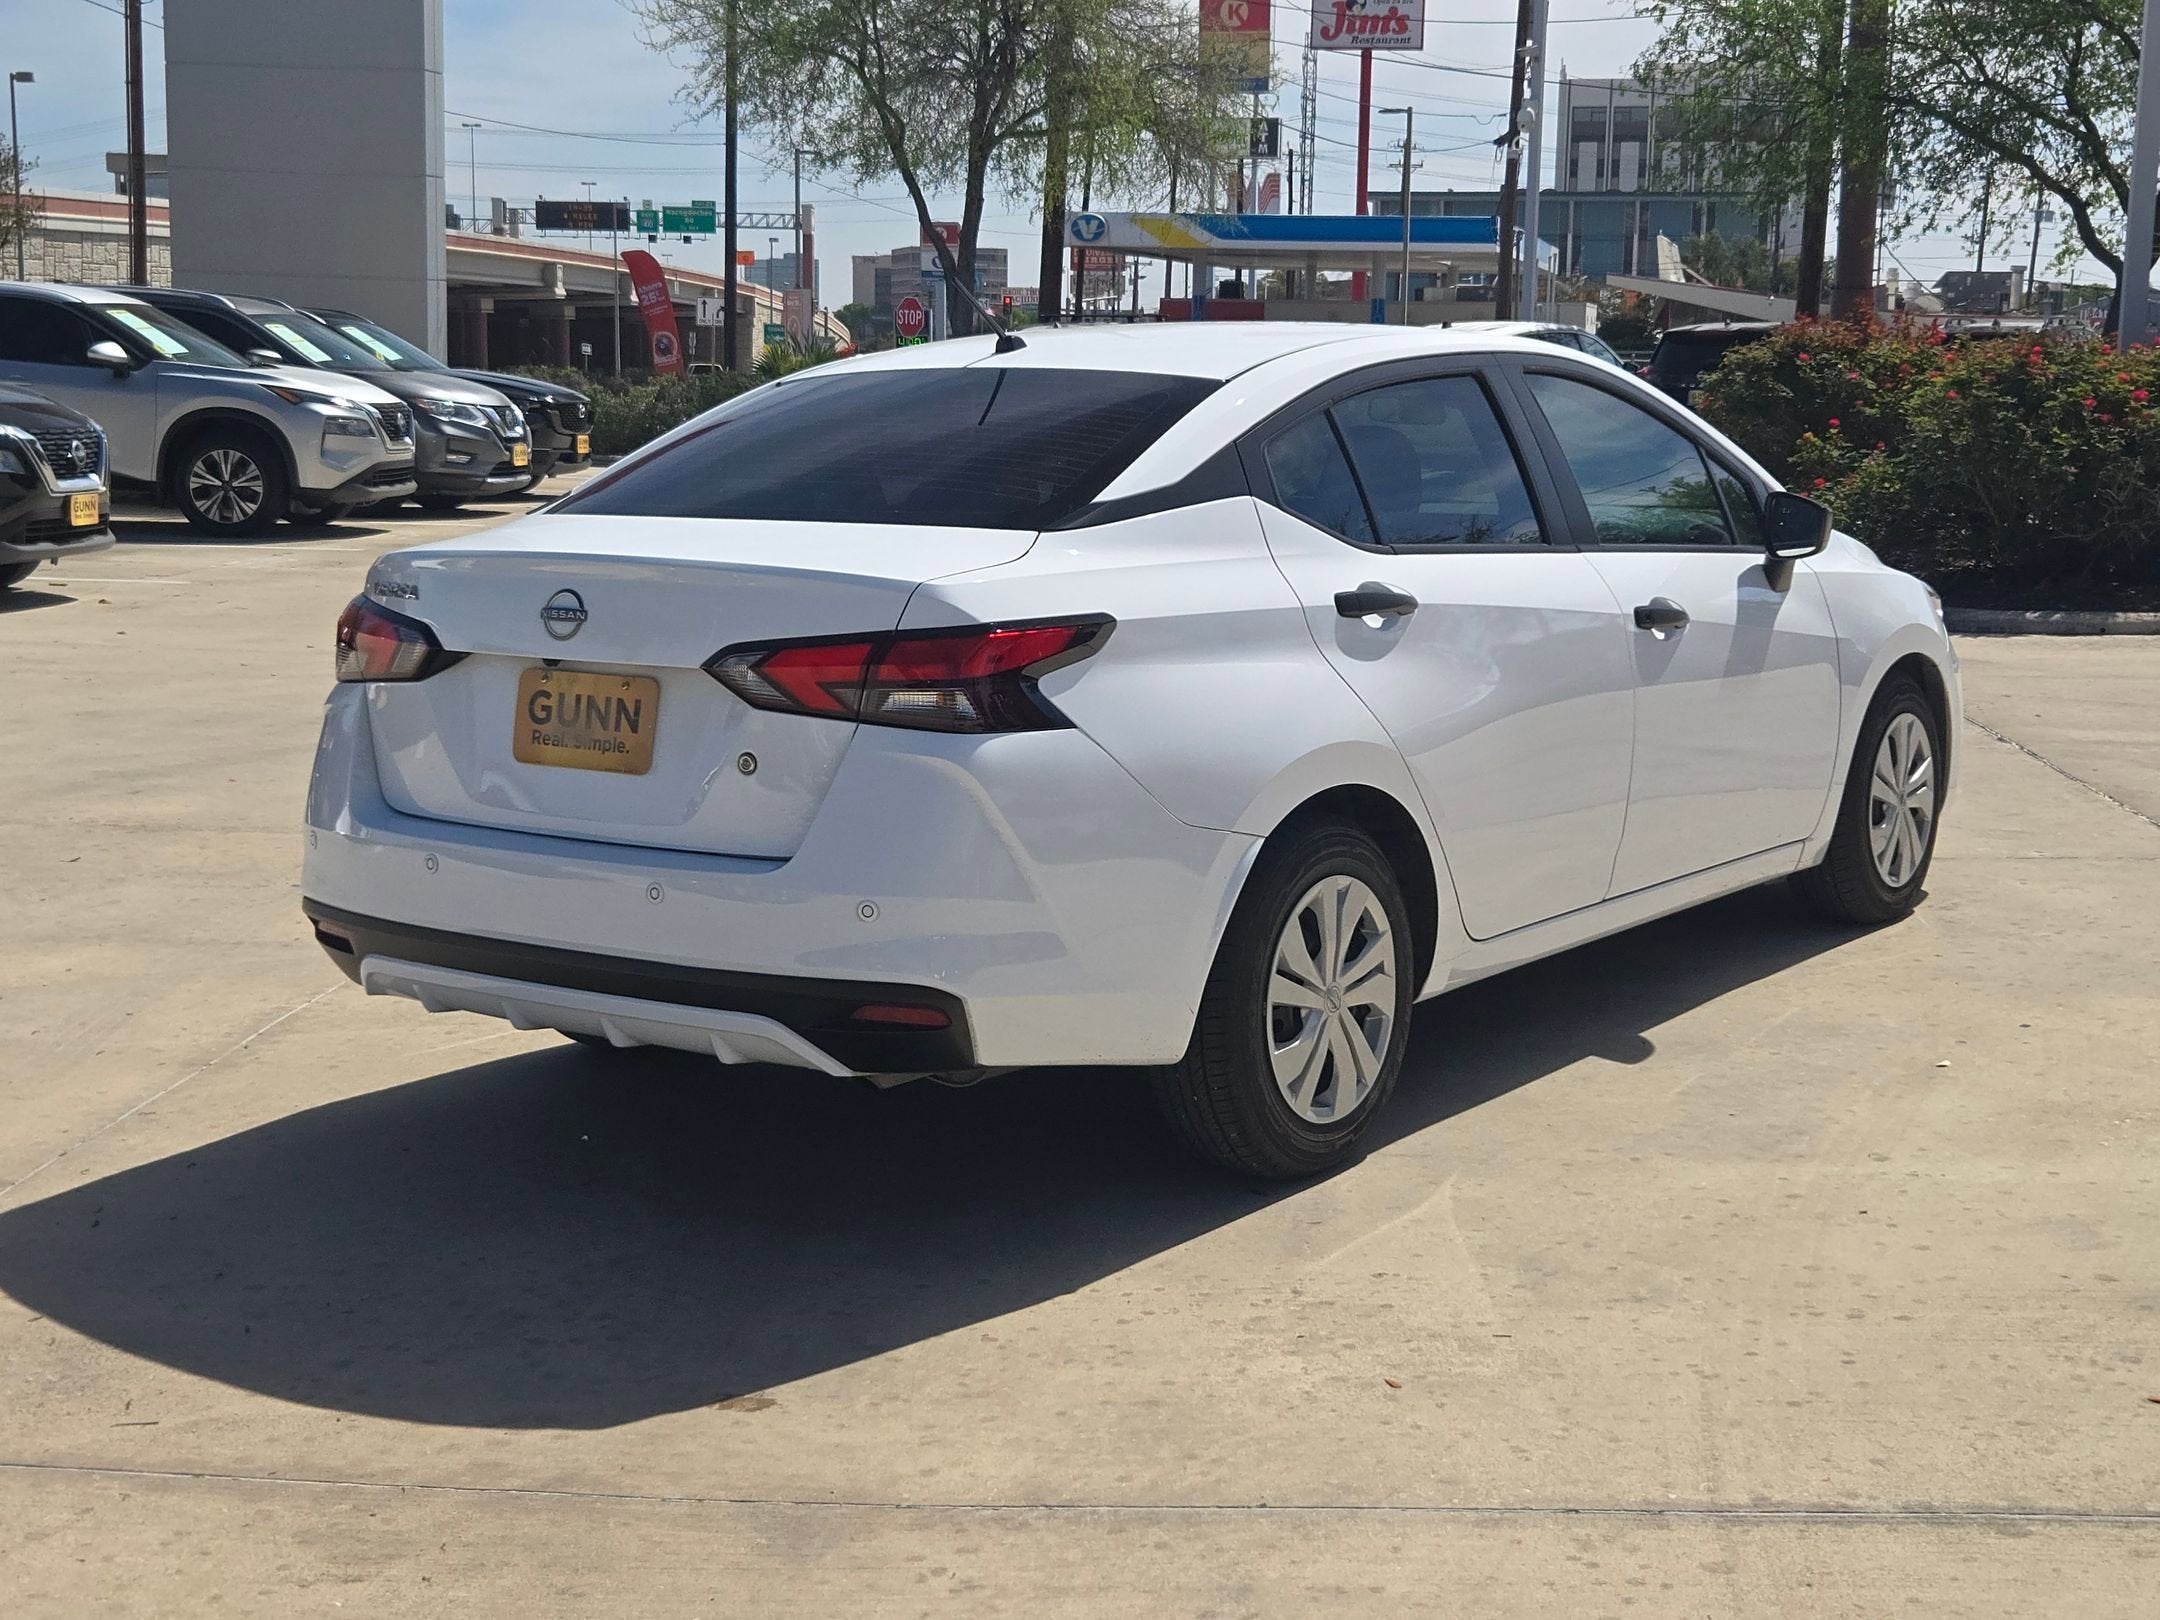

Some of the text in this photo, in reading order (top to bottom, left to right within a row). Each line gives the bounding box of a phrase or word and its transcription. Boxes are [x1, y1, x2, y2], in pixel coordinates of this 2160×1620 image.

[1320, 0, 1410, 41] Jim's
[1350, 35, 1411, 44] Restaurant
[1257, 121, 1269, 154] ATM
[898, 310, 922, 325] STOP
[73, 499, 96, 513] GUNN
[542, 610, 586, 620] NISSAN
[528, 689, 642, 734] GUNN
[532, 730, 568, 748] Real.
